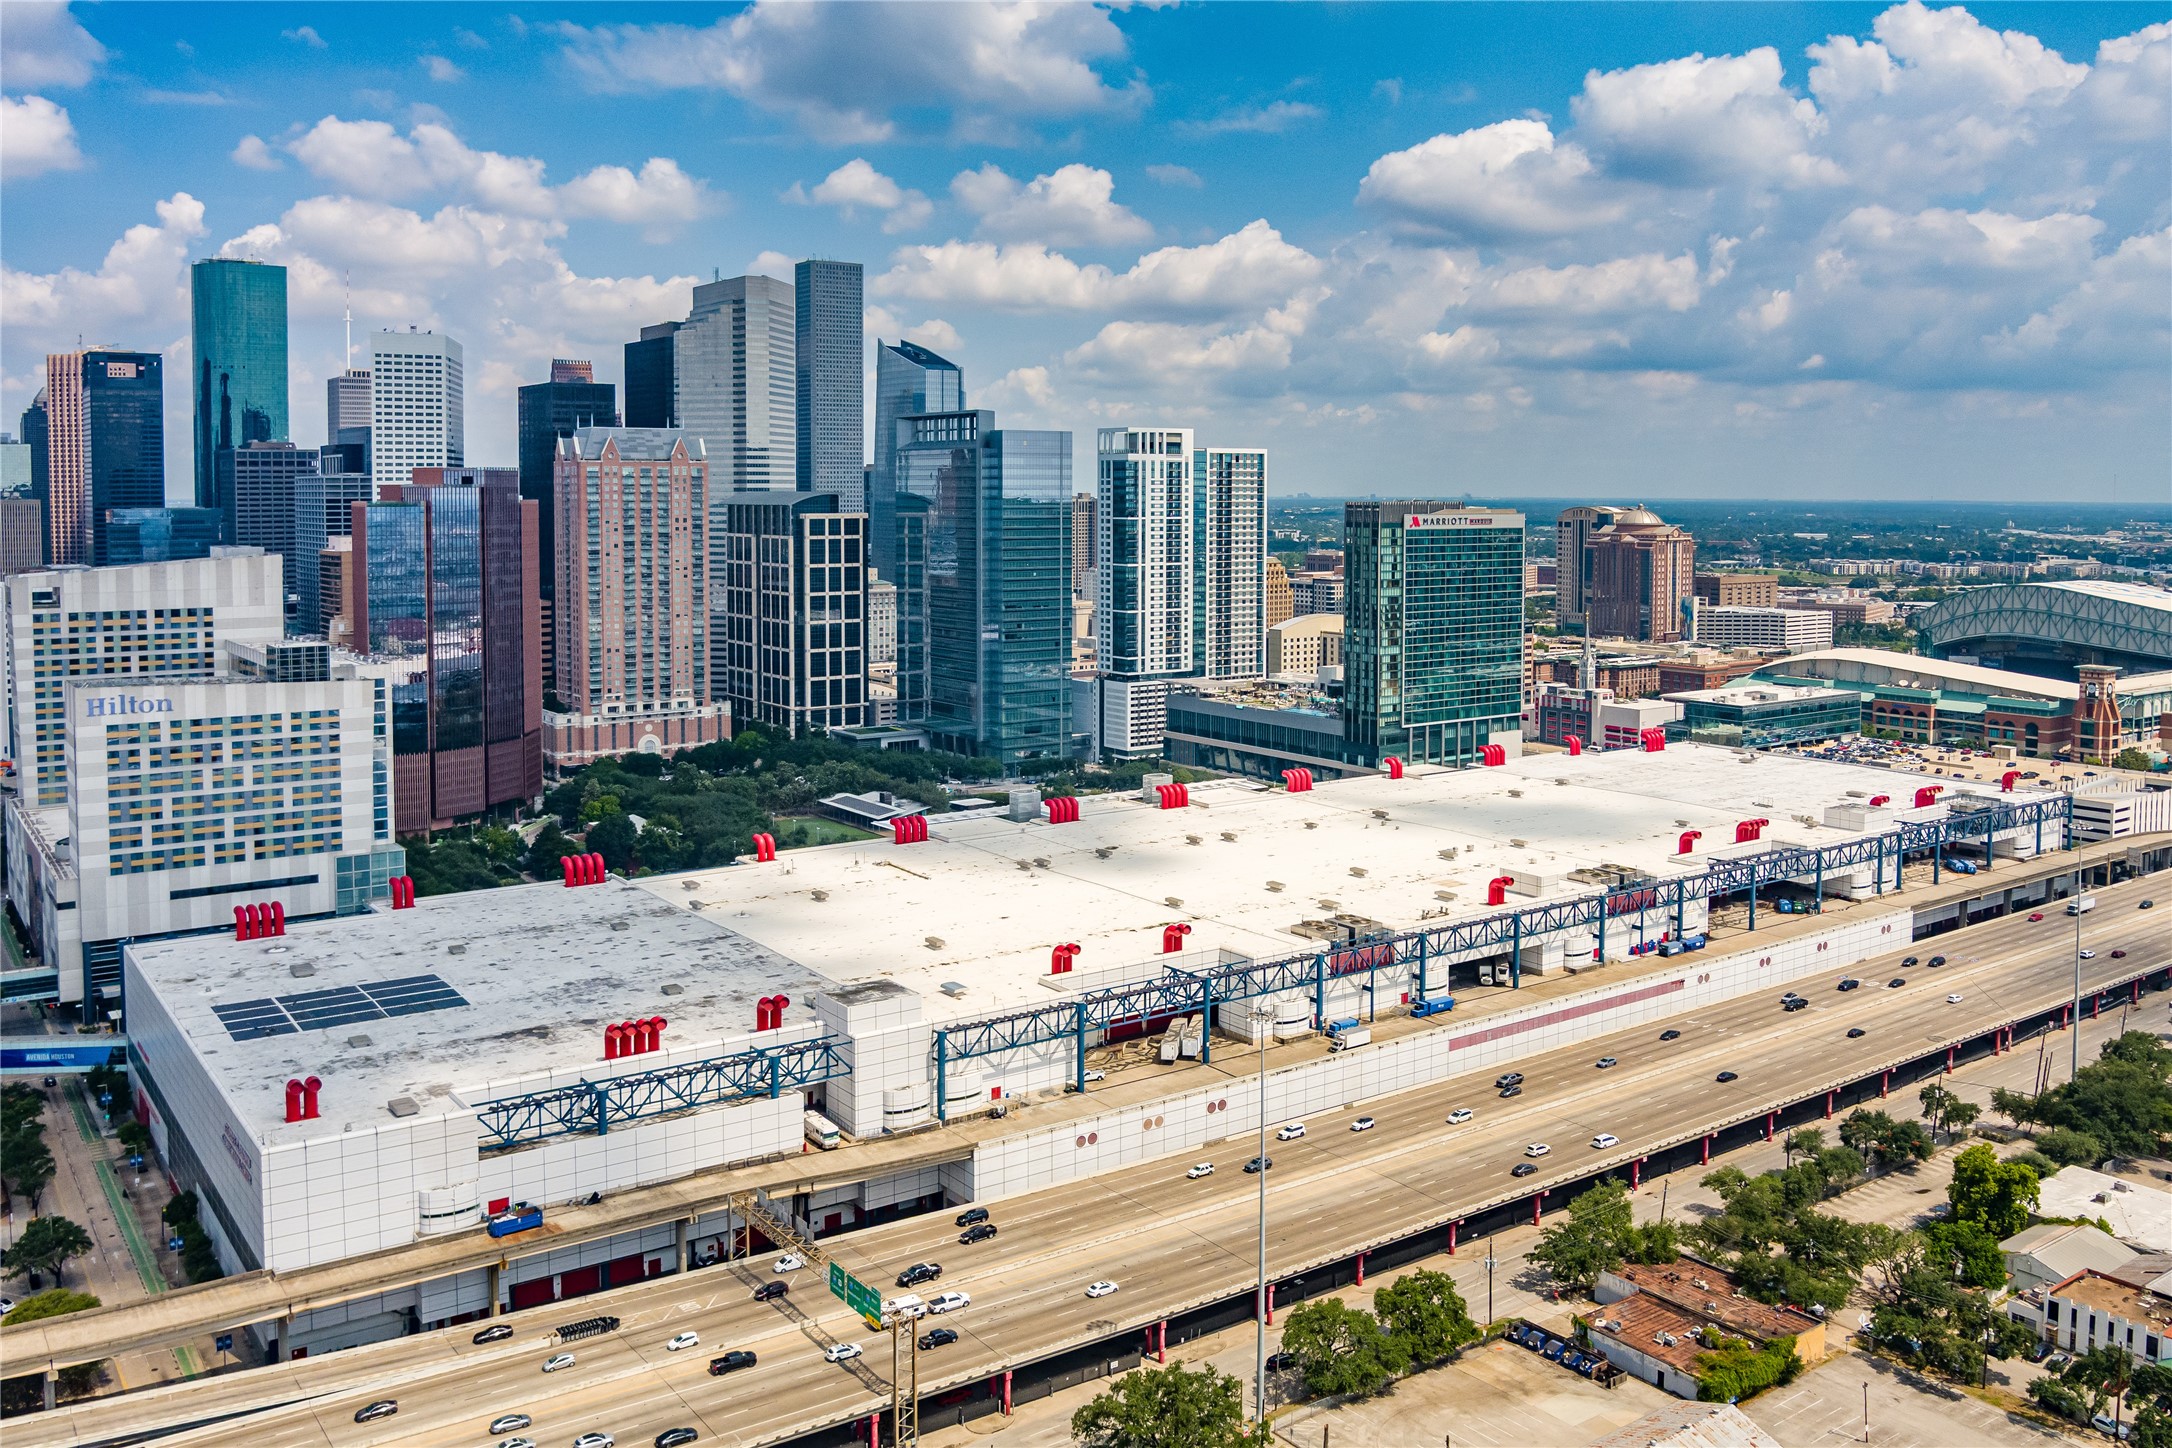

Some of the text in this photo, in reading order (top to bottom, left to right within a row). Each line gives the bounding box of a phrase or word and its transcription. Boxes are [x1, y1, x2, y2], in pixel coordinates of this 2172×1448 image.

[1422, 517, 1468, 526] MARRIOTT
[86, 694, 174, 717] Hilton
[26, 1053, 50, 1061] AVENIDA
